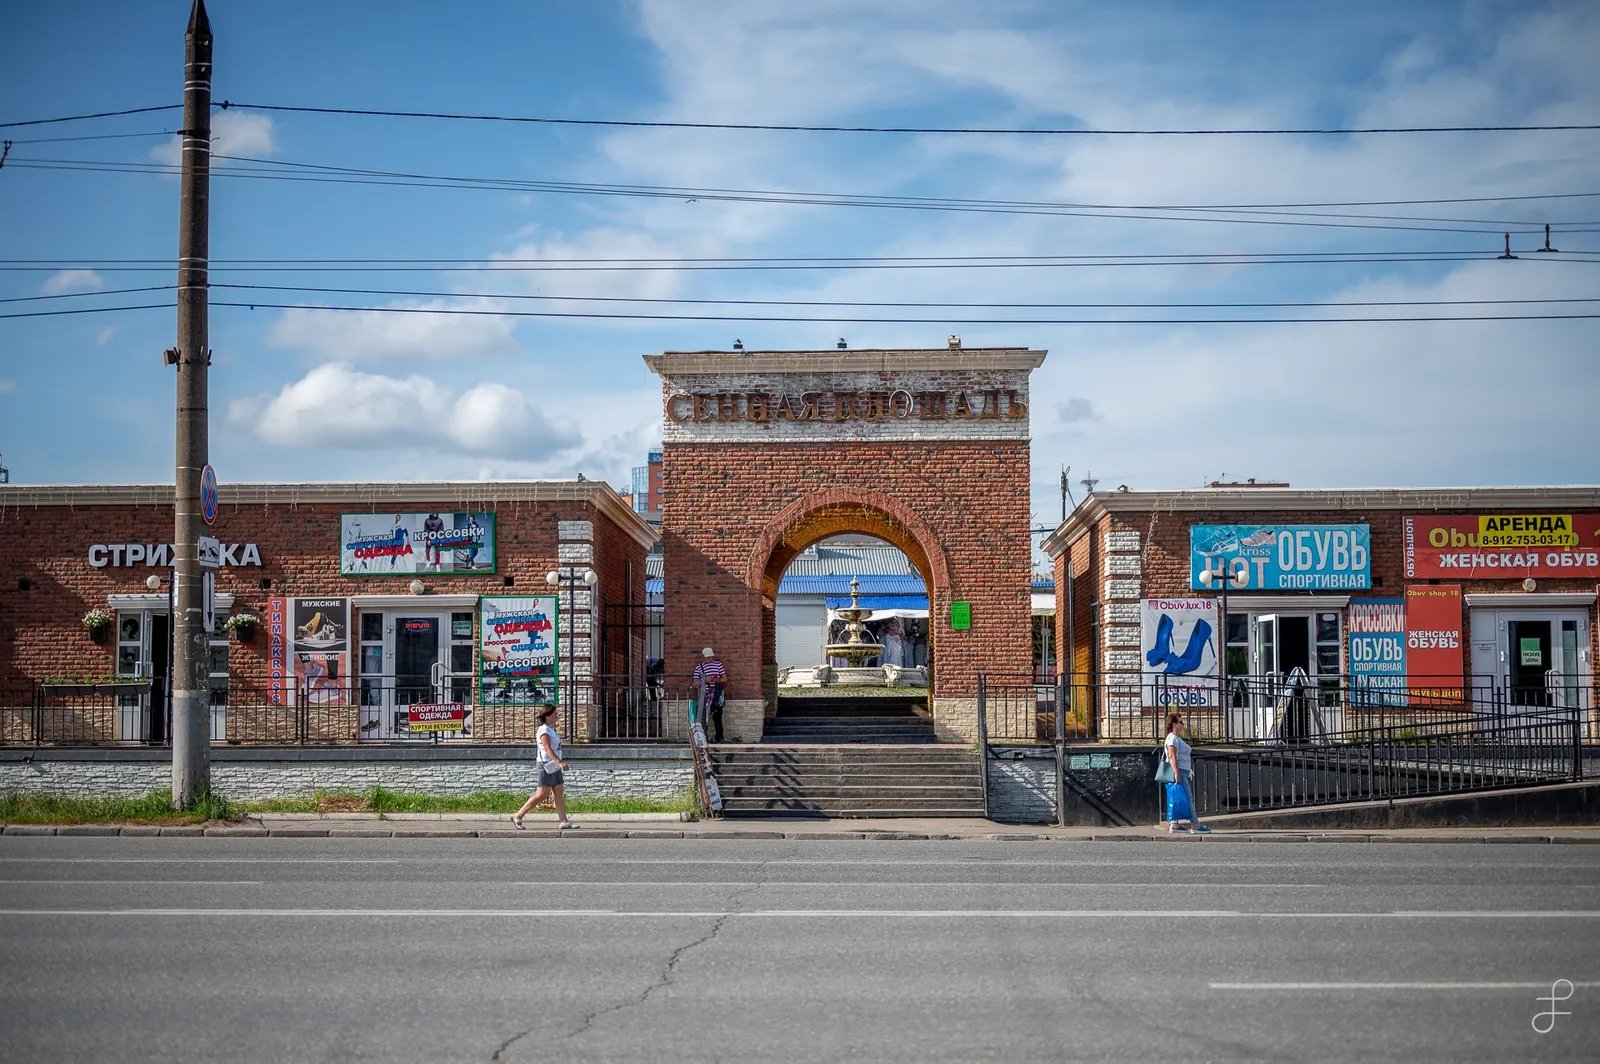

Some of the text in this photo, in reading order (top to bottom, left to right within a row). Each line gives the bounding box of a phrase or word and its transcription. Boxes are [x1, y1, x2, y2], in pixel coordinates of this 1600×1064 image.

[666, 389, 1028, 423] СЕННАЯ ПЛОЩАДЬ
[1485, 516, 1567, 533] АРЕНДА
[356, 534, 393, 542] МУЖСКАЯ
[413, 525, 485, 542] КРОССОВКИ
[1482, 534, 1571, 545] 8-912-753-03-17
[88, 543, 262, 568] СТРИКА
[354, 543, 414, 559] ОДЕЖДА
[1238, 548, 1271, 556] kross
[1278, 530, 1367, 572] ОБУВЬ
[1439, 553, 1539, 568] ЖЕНСКАЯ
[1278, 574, 1366, 588] СПОРТИВНАЯ
[1429, 590, 1447, 598] shop
[302, 600, 341, 608] МУЖСКИЕ
[1160, 601, 1212, 610] Obuv.lux.18
[1350, 604, 1404, 633] КРОССОВКИ
[494, 619, 553, 635] ОДЕЖДА
[1408, 630, 1459, 638] ЖЕНСКАЯ
[511, 642, 550, 653] ОДЕЖДА
[1352, 637, 1403, 661] ОБУВЬ
[1408, 638, 1459, 649] ОБУВЬ
[483, 656, 555, 671] КРОССОВКИ
[1354, 662, 1402, 672] СПОРТИВНАЯ
[410, 704, 461, 714] СПОРТИВНАЯ
[419, 711, 452, 721] ОДЕЖДА
[434, 722, 462, 730] ВЕТРОВКИ
